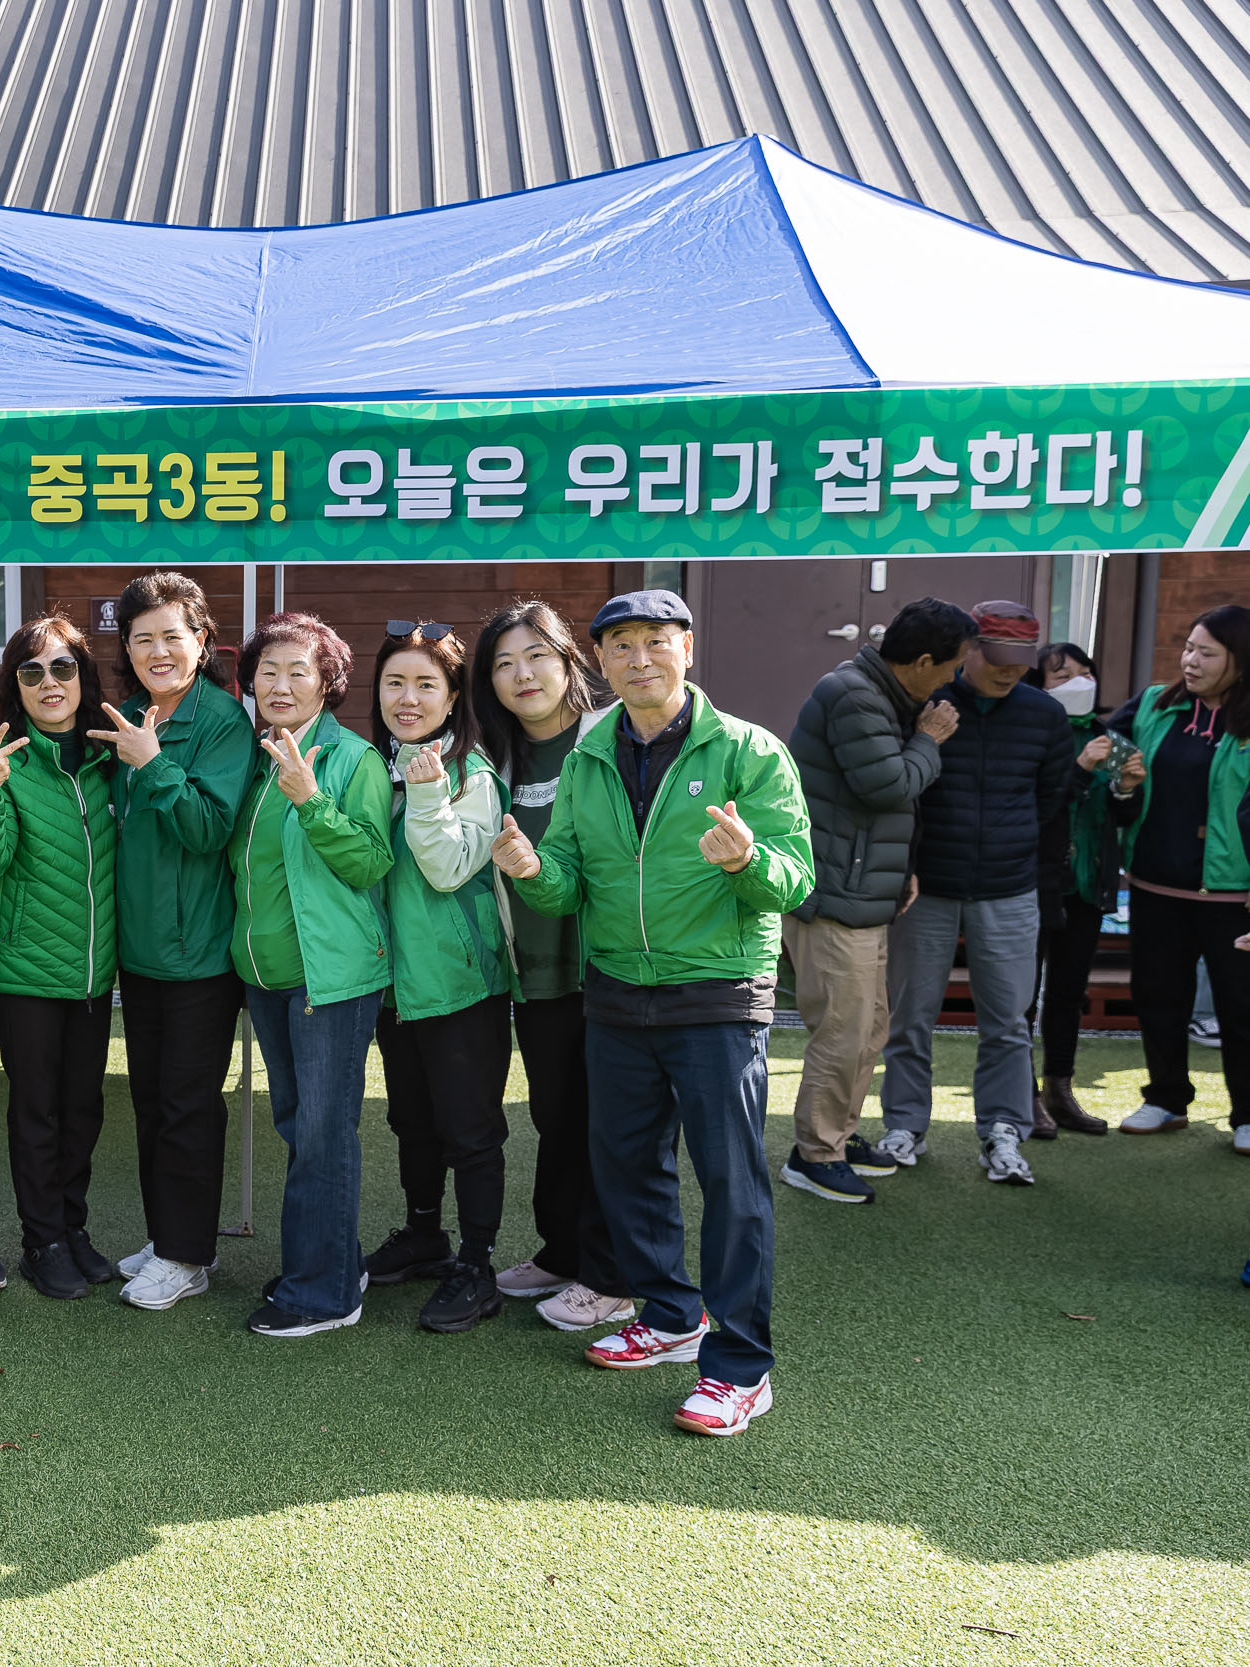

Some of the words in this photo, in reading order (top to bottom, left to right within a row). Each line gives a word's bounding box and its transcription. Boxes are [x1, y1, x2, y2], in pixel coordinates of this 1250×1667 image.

[27, 450, 287, 524] 중곡3동!
[324, 446, 528, 520] 오늘은
[564, 440, 779, 518] 우리가
[814, 429, 1144, 514] 접수한다!
